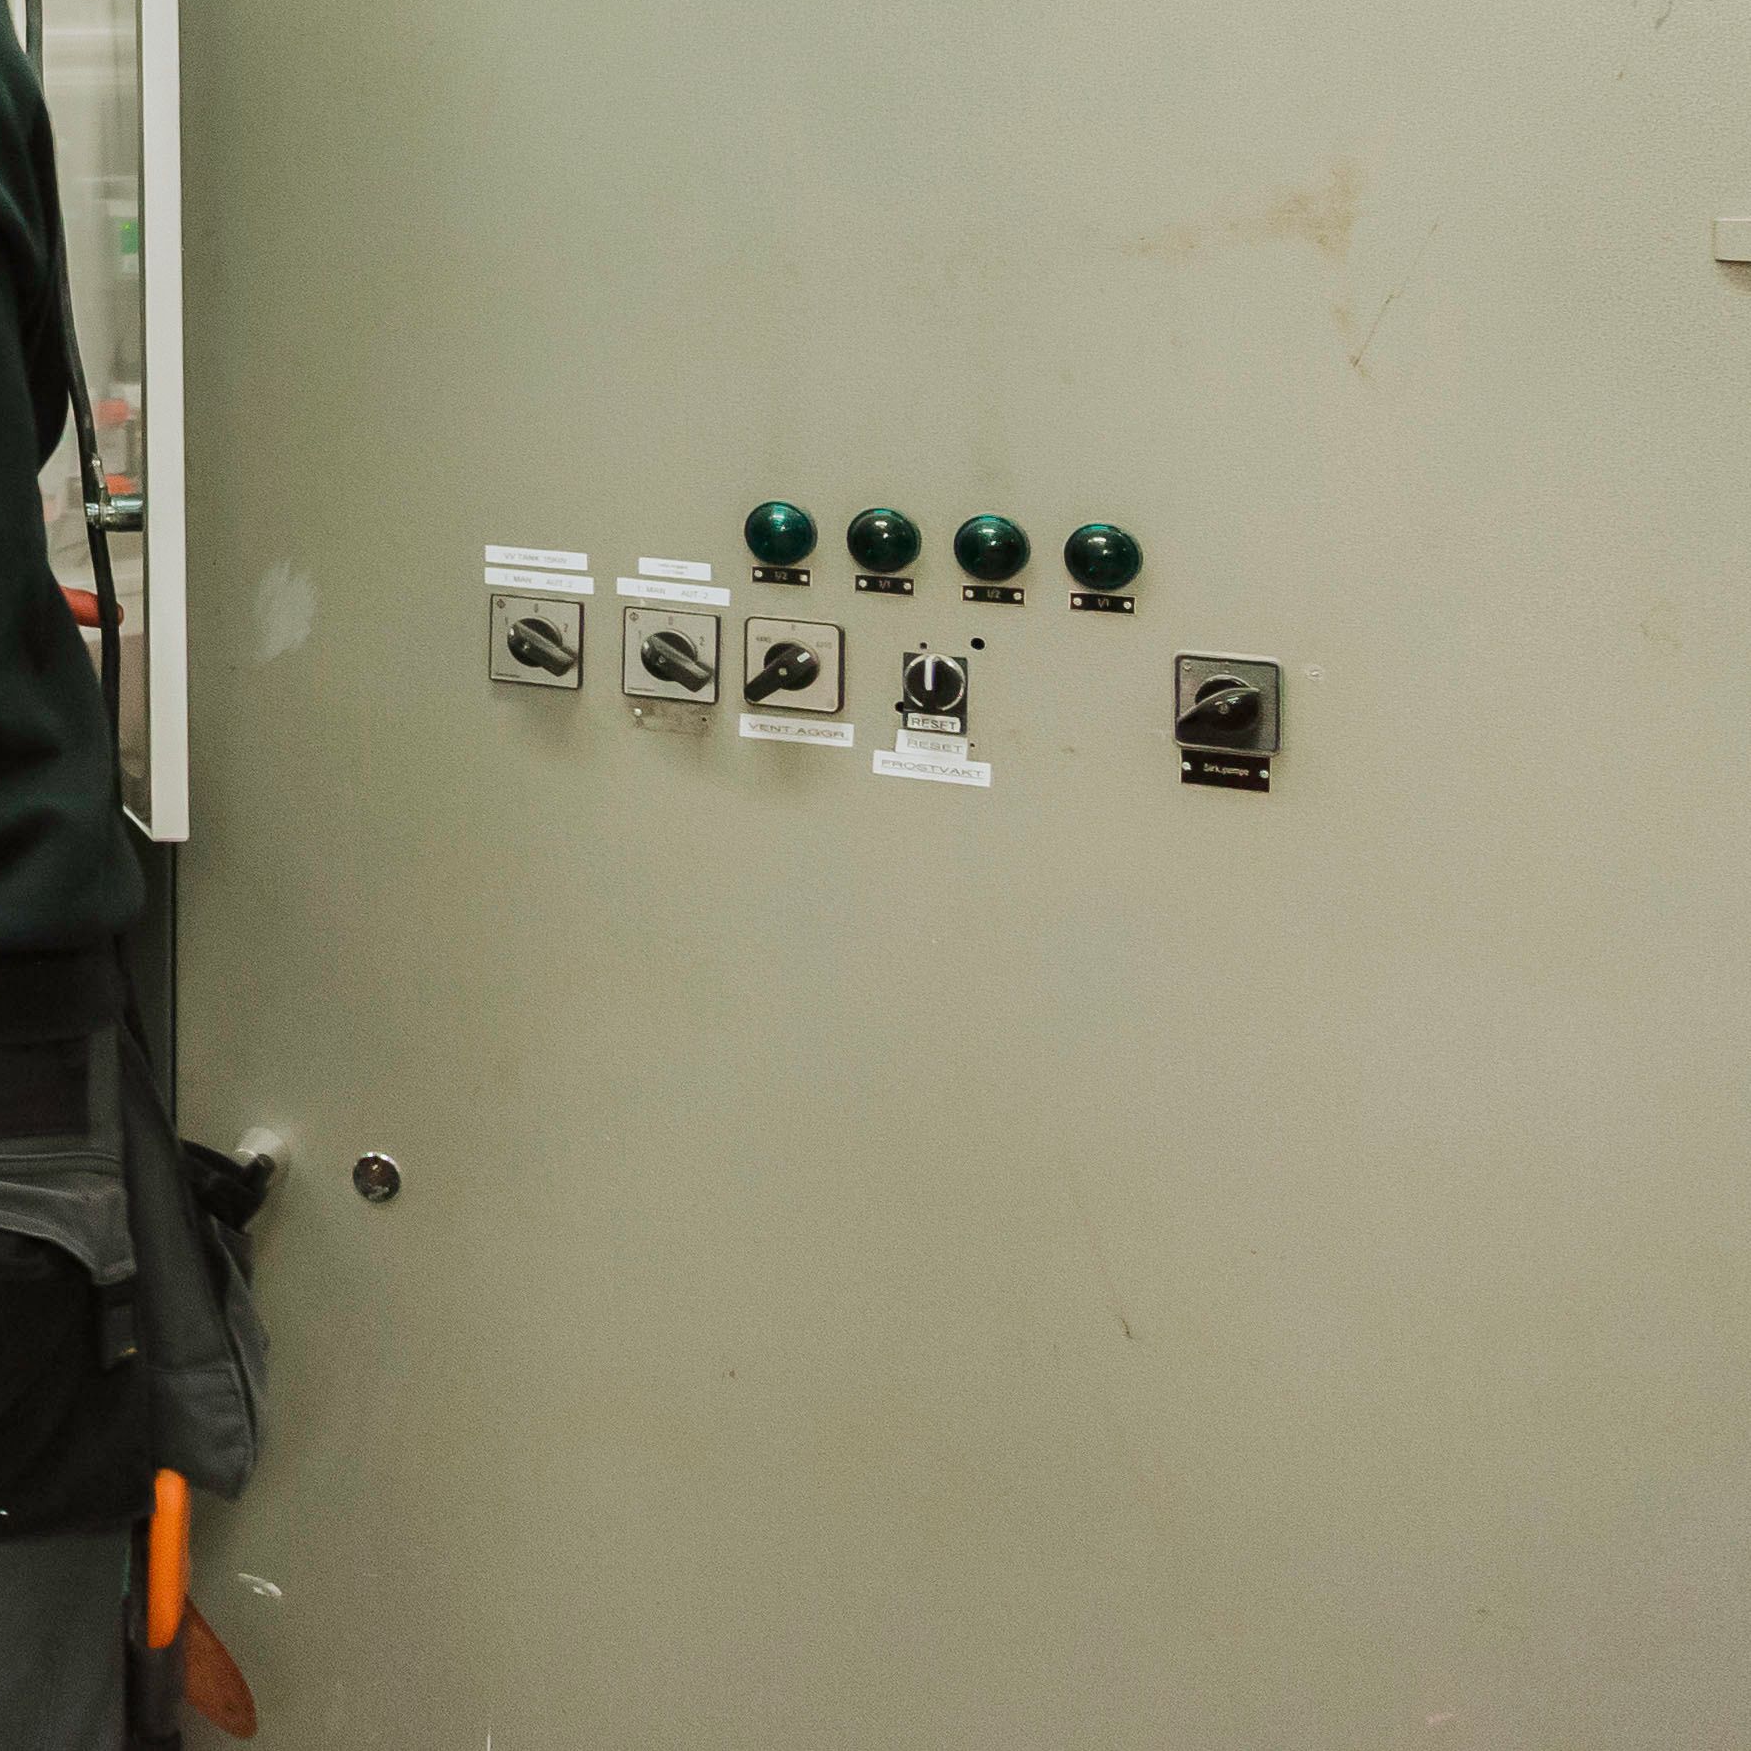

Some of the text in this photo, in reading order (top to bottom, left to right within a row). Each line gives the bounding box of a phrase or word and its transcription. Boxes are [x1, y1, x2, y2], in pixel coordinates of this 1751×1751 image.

[911, 717, 957, 731] RESET
[906, 737, 964, 753] RESET
[881, 758, 985, 779] FROSTVAKT
